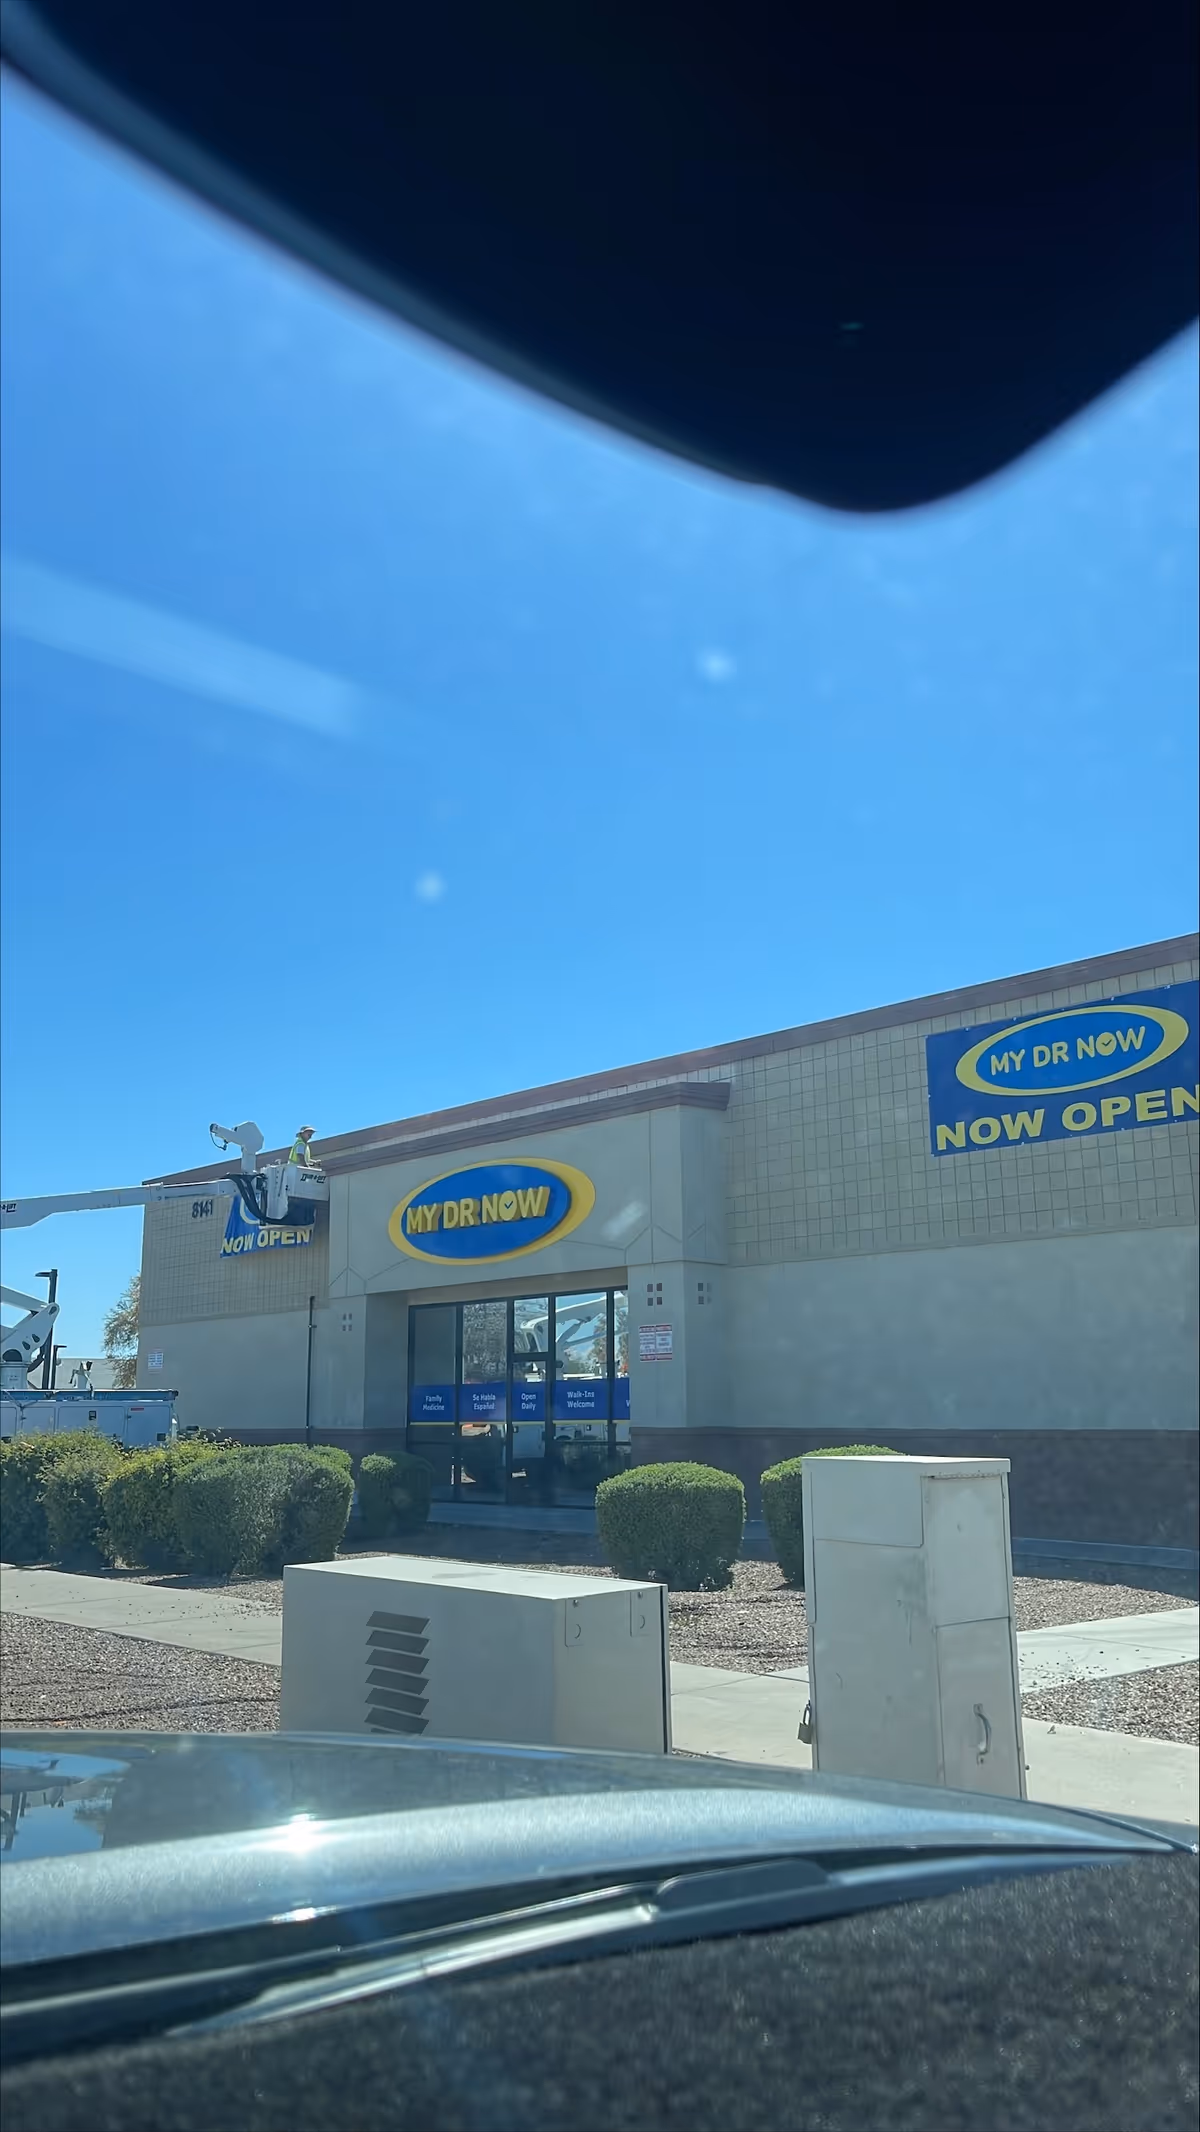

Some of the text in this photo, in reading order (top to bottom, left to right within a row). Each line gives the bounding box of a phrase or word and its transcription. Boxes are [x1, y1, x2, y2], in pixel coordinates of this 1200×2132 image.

[989, 1026, 1146, 1076] MY DR NOW
[936, 1084, 1199, 1151] NOW OPEN
[192, 1200, 213, 1219] 8141
[406, 1186, 550, 1234] MY DR NOW
[220, 1229, 311, 1254] NOW OPEN
[425, 1394, 443, 1404] Family
[472, 1392, 496, 1401] Se Habla
[521, 1393, 536, 1401] Open
[567, 1390, 595, 1399] Walk-Ins
[422, 1402, 445, 1411] Medicine
[473, 1402, 495, 1411] Español
[521, 1402, 536, 1411] Daily
[567, 1400, 595, 1408] Welcome
